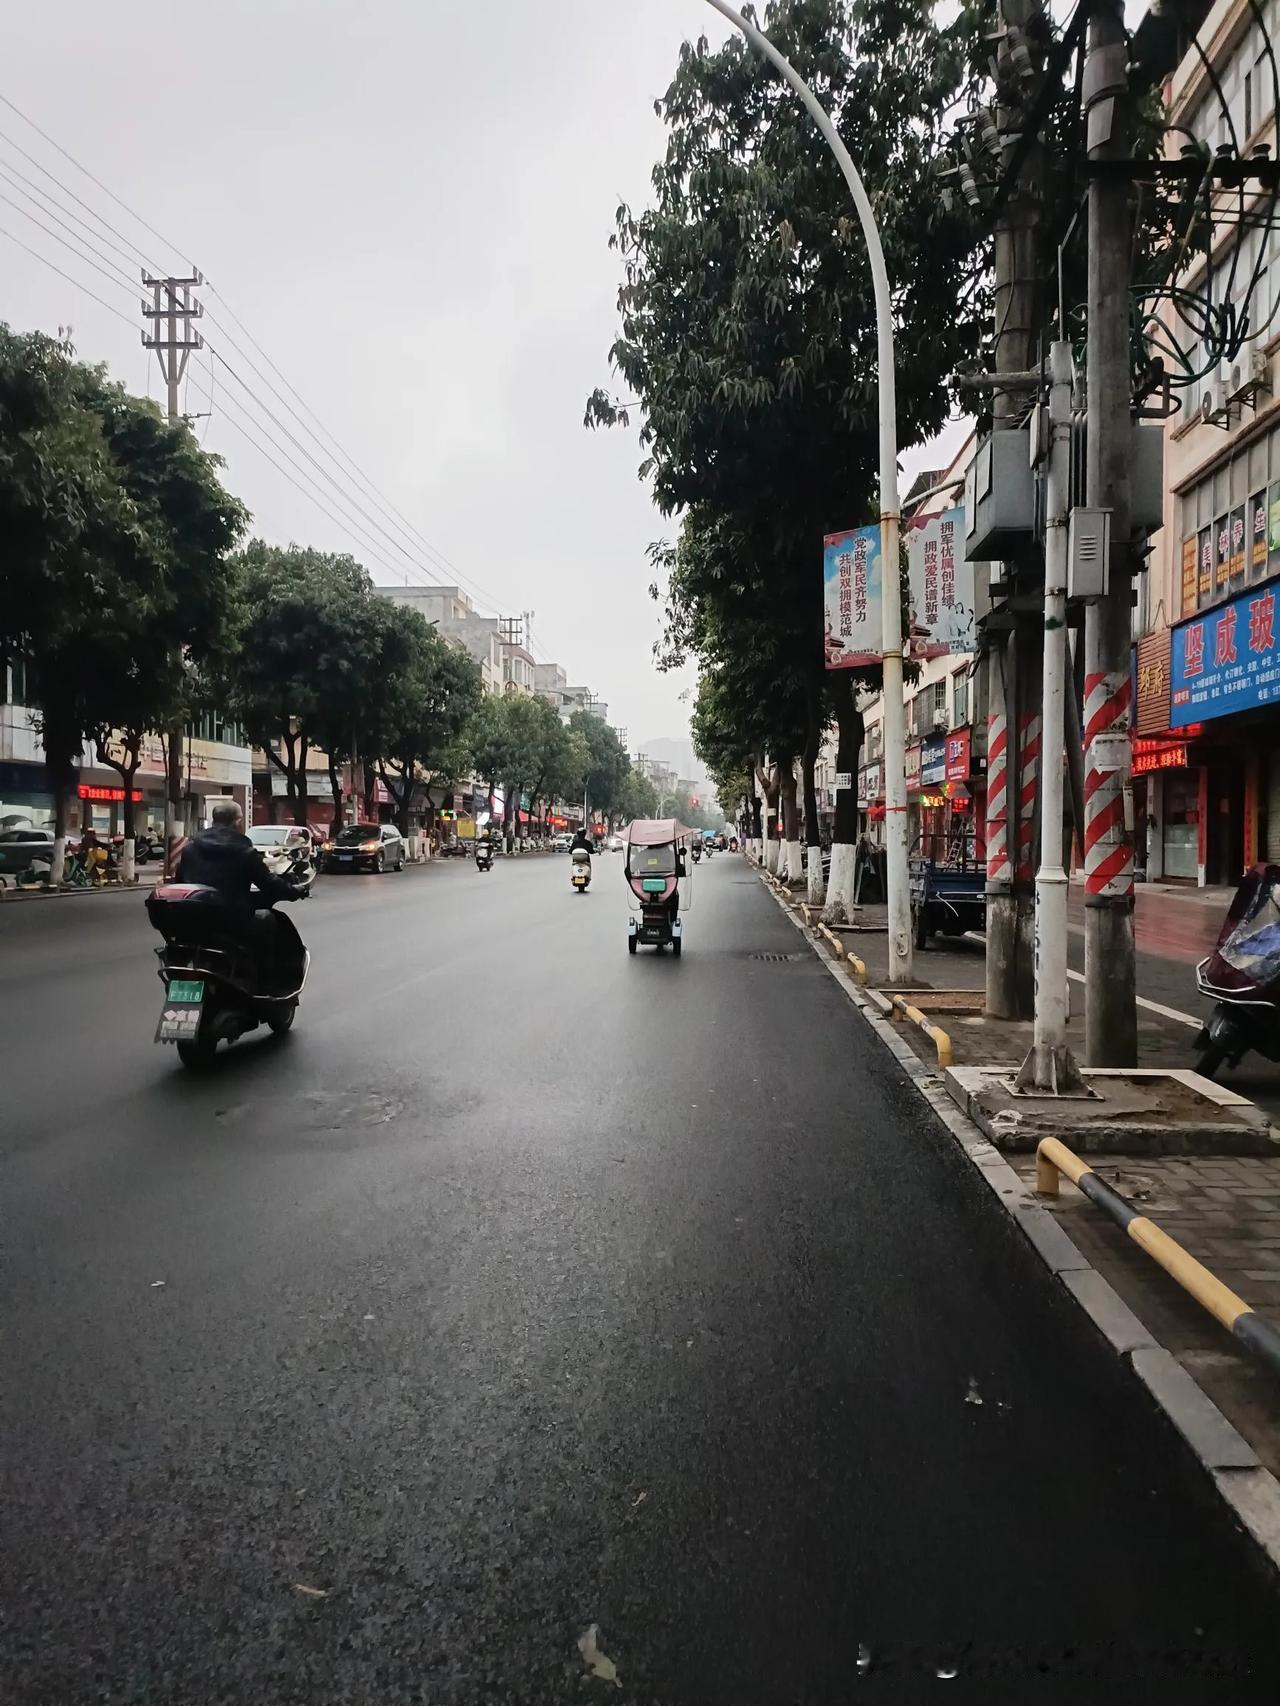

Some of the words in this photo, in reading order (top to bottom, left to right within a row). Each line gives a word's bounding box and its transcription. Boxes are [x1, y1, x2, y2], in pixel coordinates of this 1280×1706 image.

[839, 553, 852, 638] 共创双拥模范城
[854, 537, 867, 623] 党政军民齐努力
[924, 540, 939, 626] 拥政爱民谱新章
[940, 520, 955, 609] 拥军优属创佳绩
